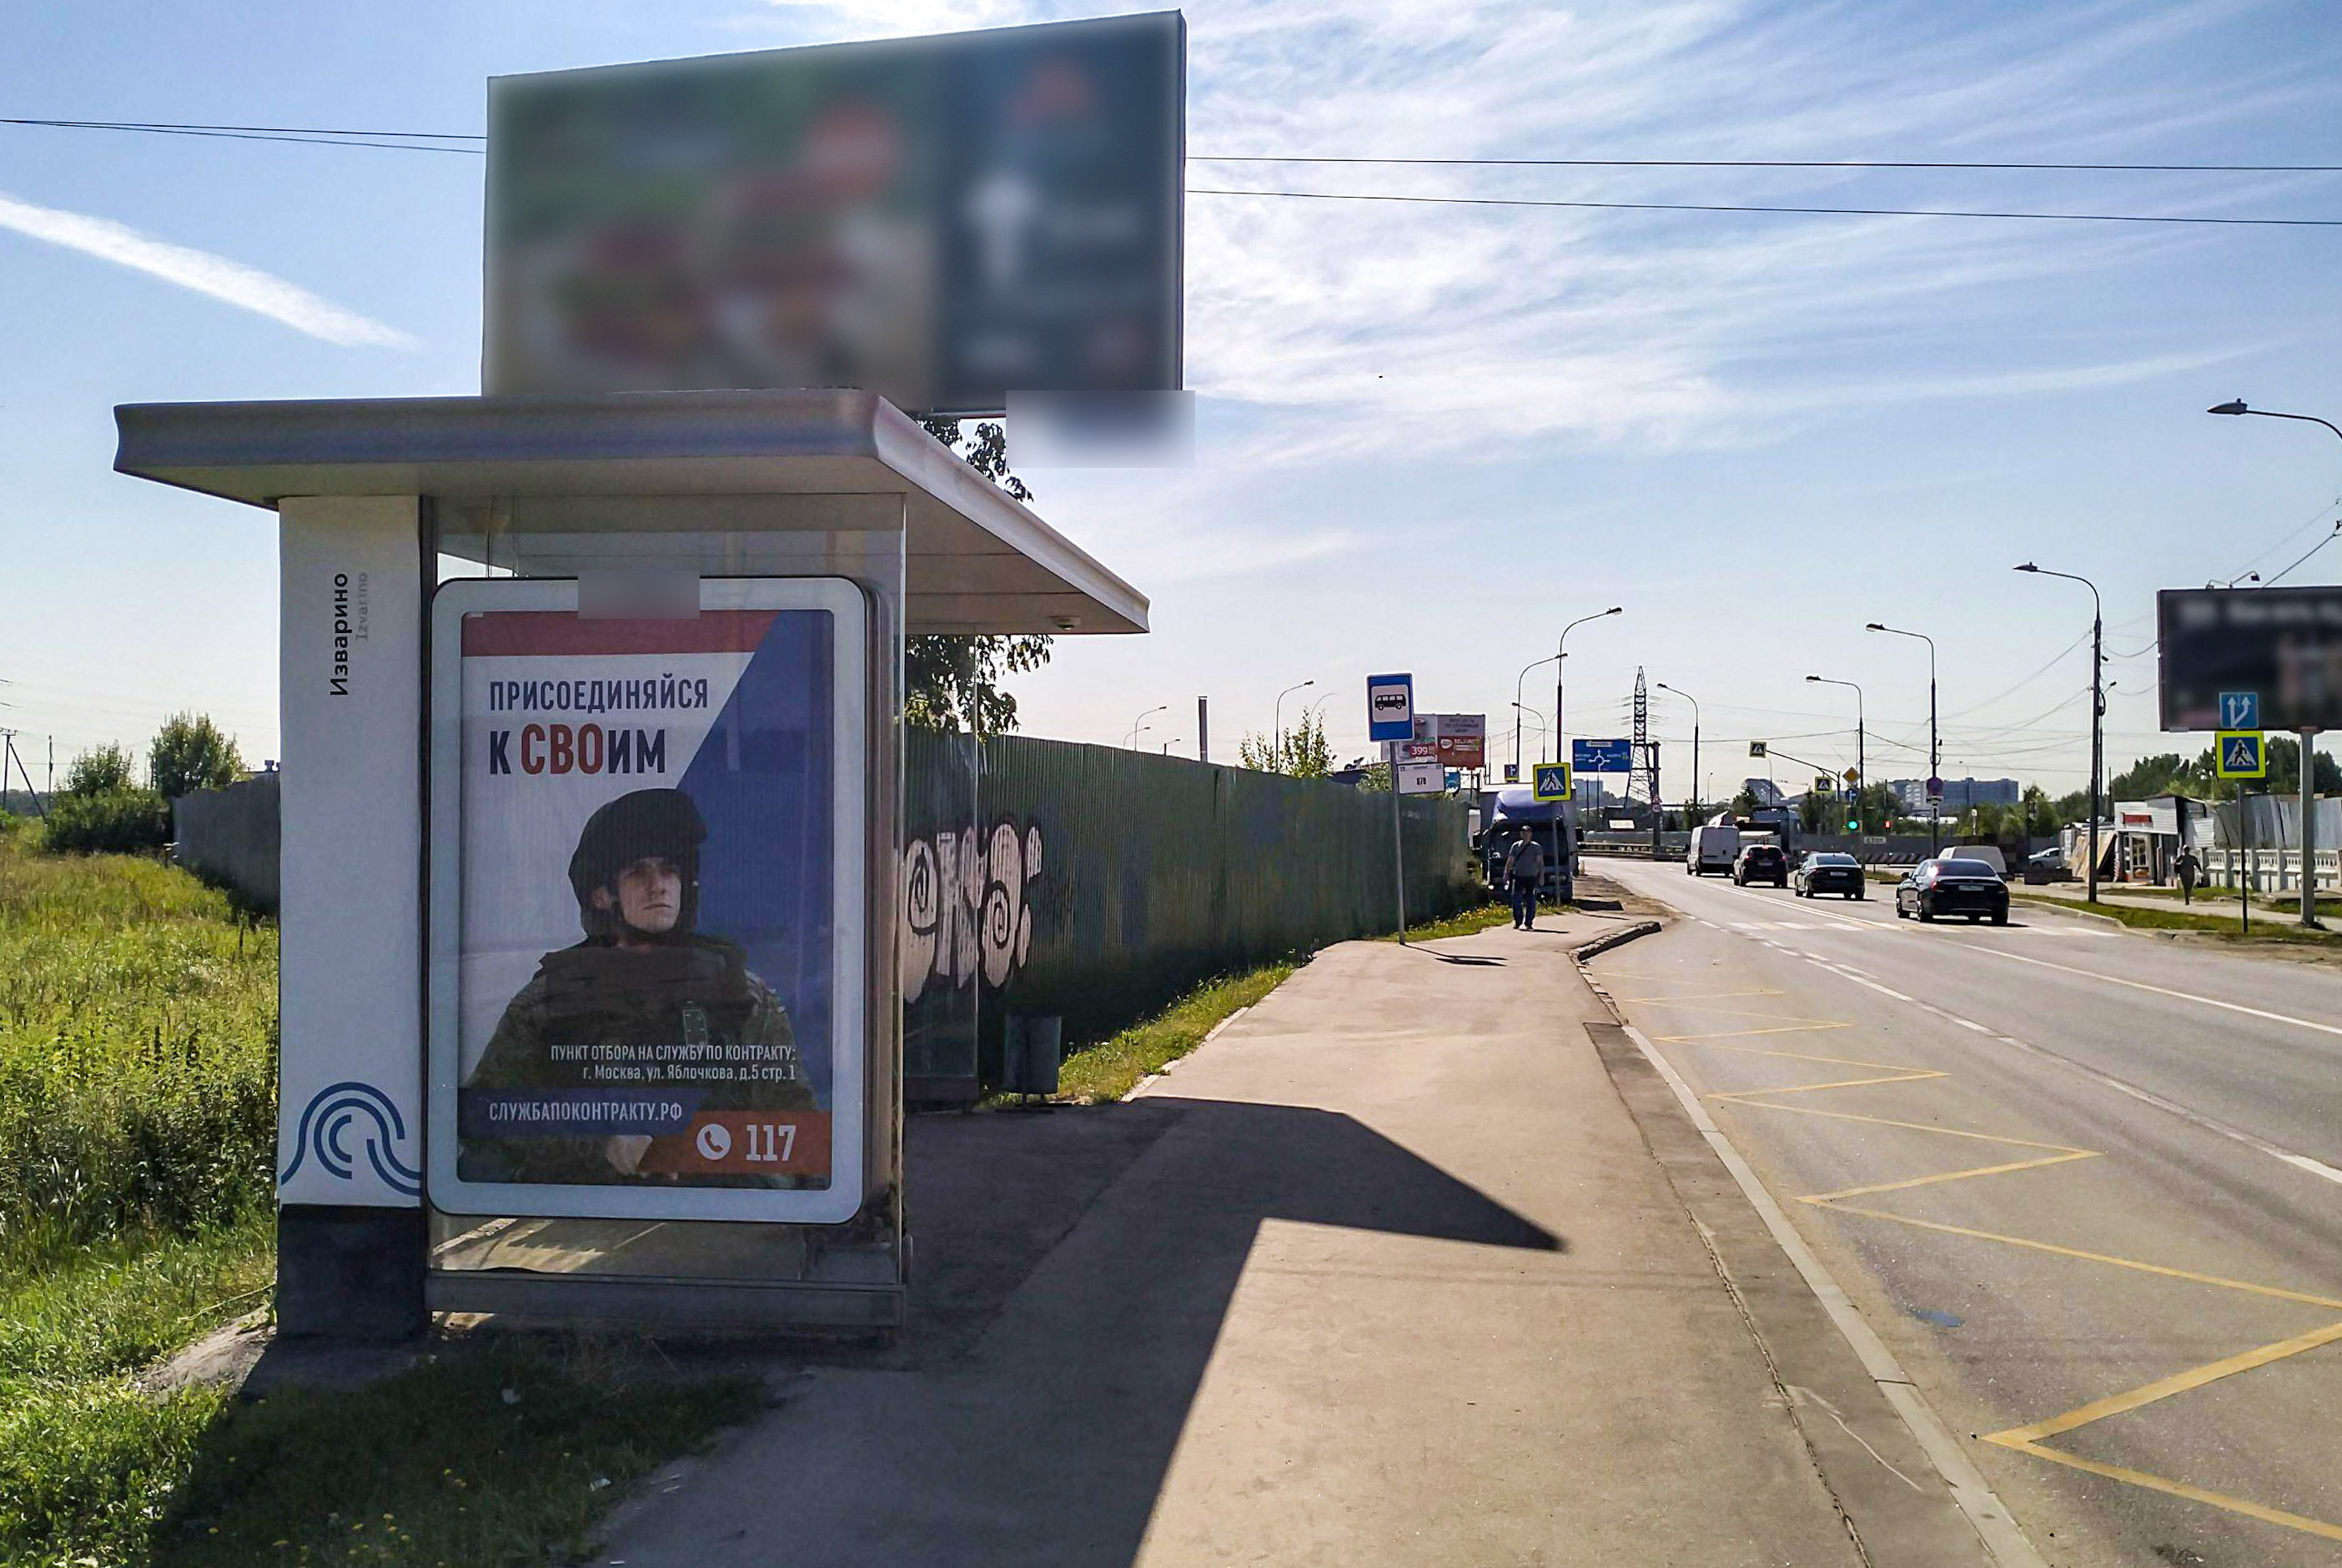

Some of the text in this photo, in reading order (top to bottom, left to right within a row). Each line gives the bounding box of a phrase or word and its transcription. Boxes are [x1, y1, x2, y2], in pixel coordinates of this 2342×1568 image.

[355, 572, 368, 641] Izvarino
[330, 573, 352, 695] Изварино
[490, 673, 708, 713] ПРИСОЕДИНЯЙСЯ
[1411, 746, 1428, 755] 399
[550, 1044, 796, 1061] ПУНКТ ОТБОРА НА СЛУЖБУ ПО КОНТРАКТУ:
[583, 1067, 591, 1079] г.
[595, 1065, 645, 1081] Москва,
[647, 1068, 664, 1082] ул.
[667, 1065, 737, 1081] Яблочкова,
[761, 1068, 786, 1083] стр.
[789, 1065, 796, 1079] 1
[490, 1102, 683, 1121] СЛУЖБАПОКОНТРАКТУ.РФ
[746, 1124, 797, 1161] 117
